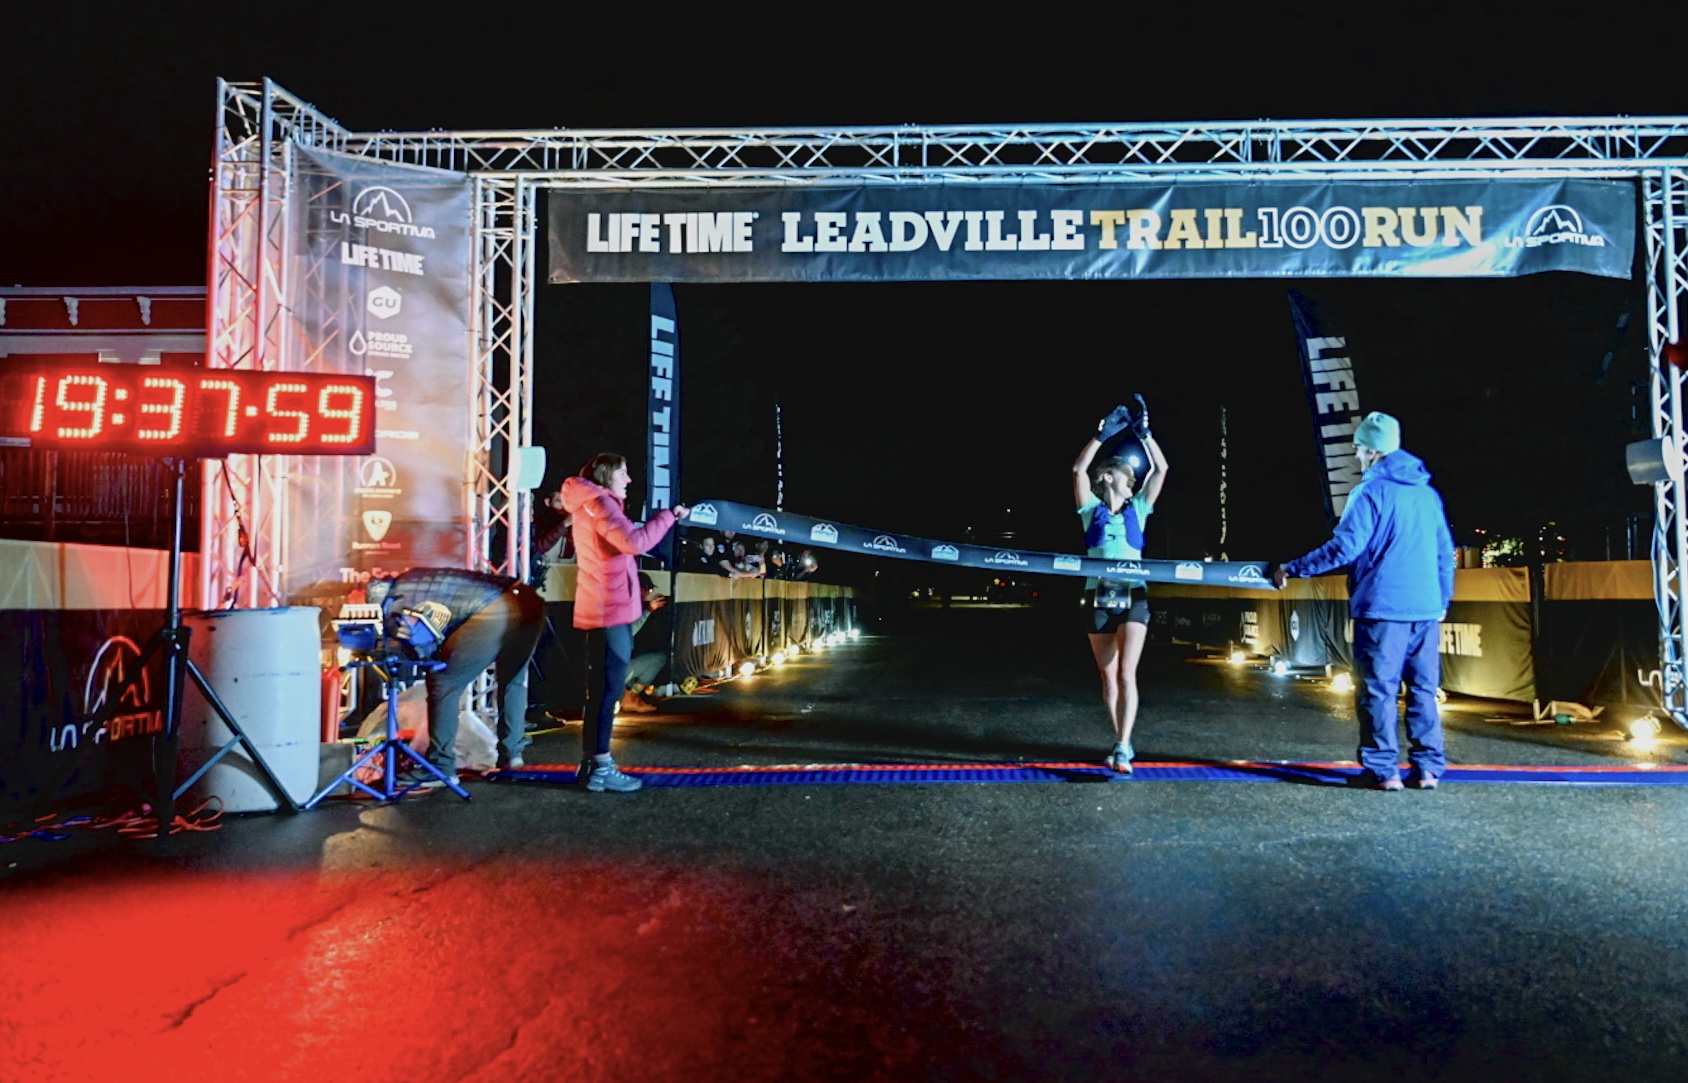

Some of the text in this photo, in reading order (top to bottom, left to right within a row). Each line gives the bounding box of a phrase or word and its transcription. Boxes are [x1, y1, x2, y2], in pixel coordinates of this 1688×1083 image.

[330, 210, 436, 239] LA SPORTIVA
[587, 205, 1484, 254] LIFE TIME LEADVILLE TRAIL 100 RUN
[1525, 231, 1605, 248] SPORTIVA
[341, 241, 425, 276] LIFE TIME
[372, 296, 397, 309] GU
[367, 330, 409, 344] PROUD
[367, 341, 413, 354] SOURCE
[1306, 336, 1360, 415] LIFE
[651, 314, 675, 510] LIFE TIME
[340, 567, 371, 583] The
